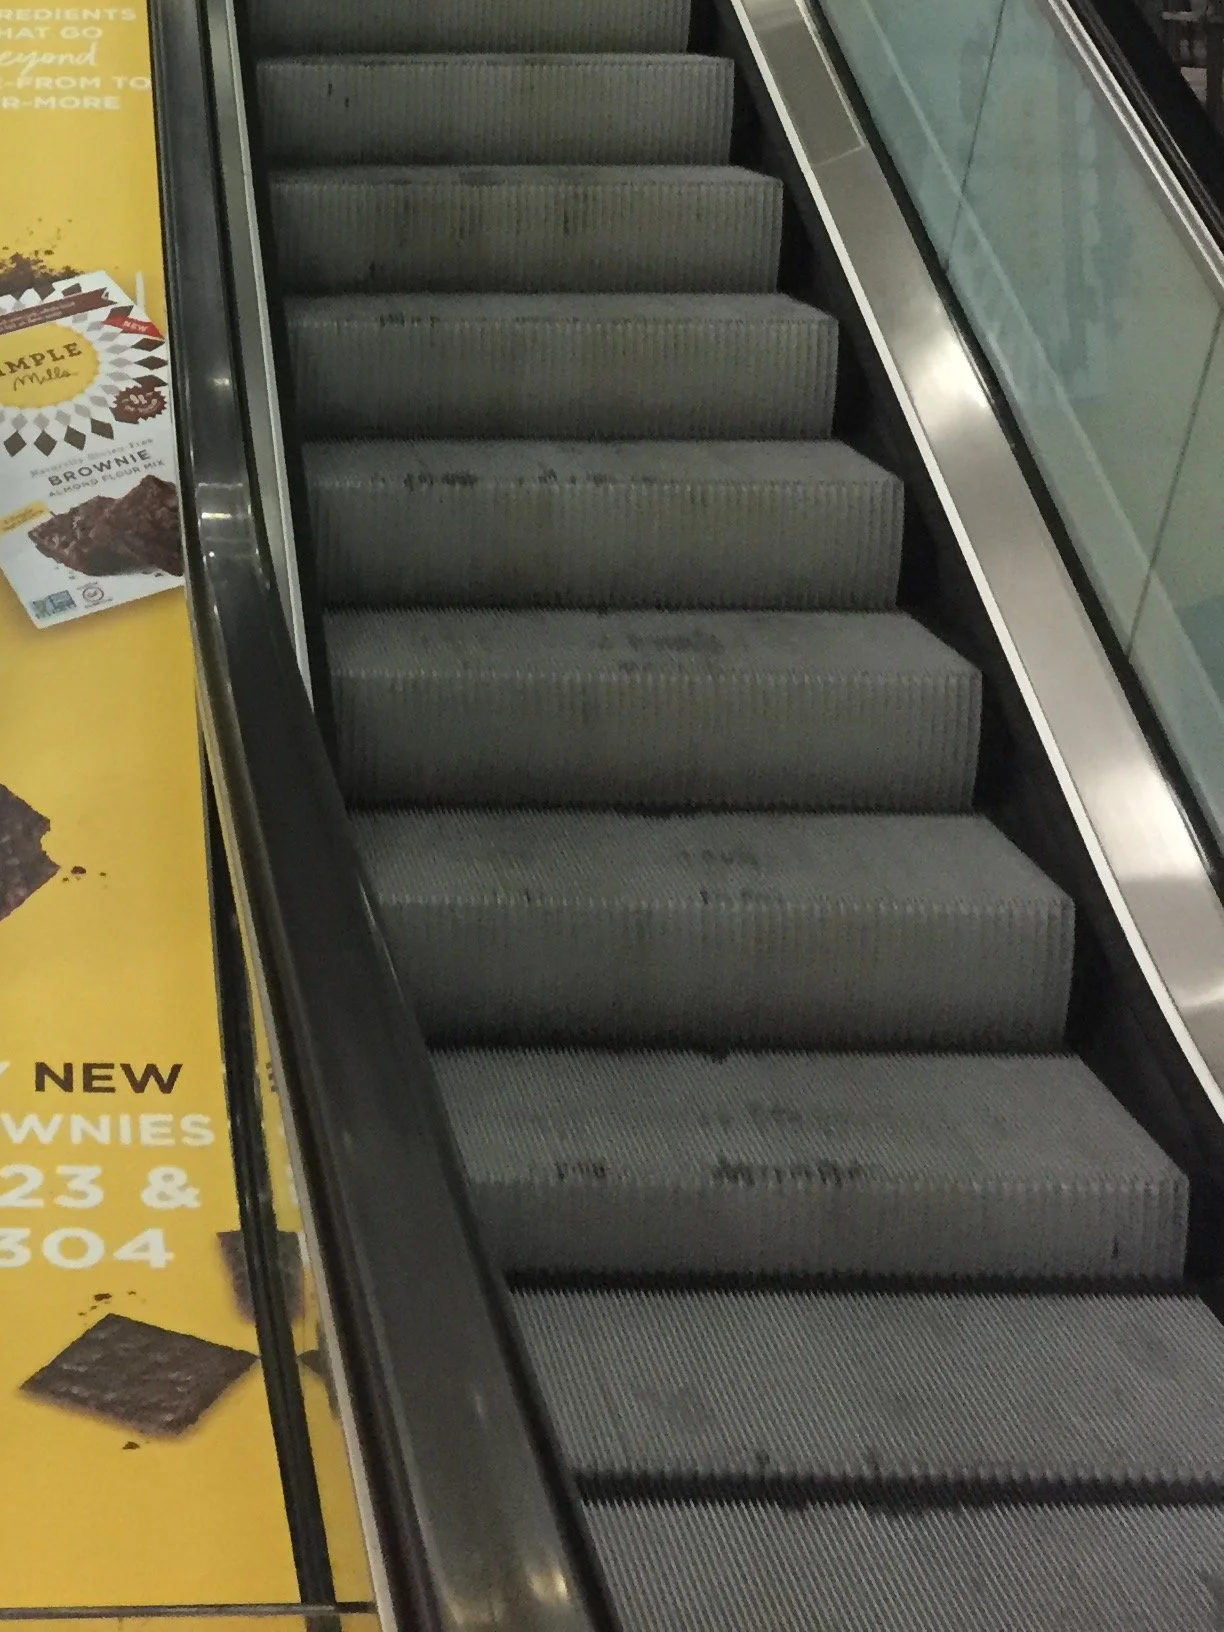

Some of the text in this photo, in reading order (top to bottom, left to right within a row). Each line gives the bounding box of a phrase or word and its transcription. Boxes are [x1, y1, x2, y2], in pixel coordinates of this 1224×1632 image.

[59, 26, 104, 40] GO
[112, 76, 152, 90] TO
[123, 320, 149, 333] NEW
[12, 366, 80, 392] Mills
[47, 449, 151, 487] BROWNIE
[49, 459, 165, 498] ALMOND FLOUR MIX
[34, 1062, 184, 1095] NEW
[139, 1164, 204, 1211] &
